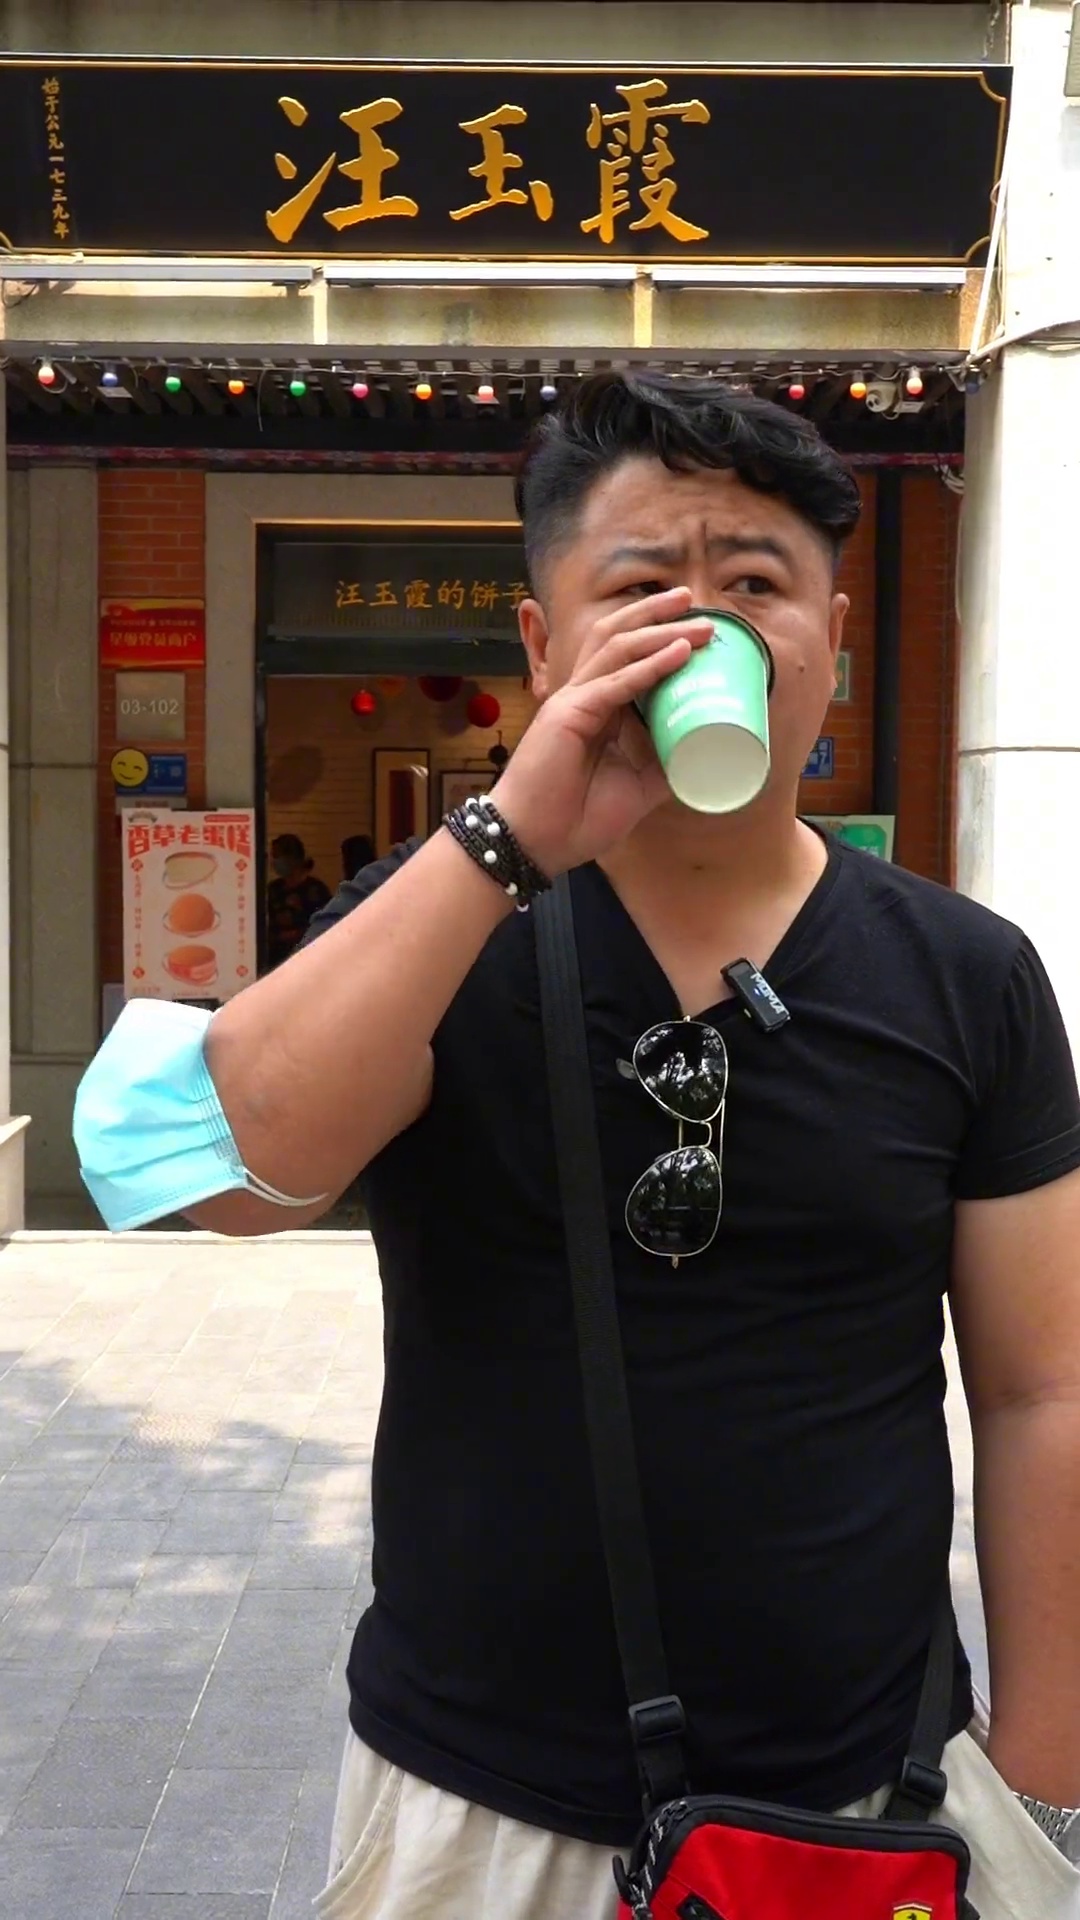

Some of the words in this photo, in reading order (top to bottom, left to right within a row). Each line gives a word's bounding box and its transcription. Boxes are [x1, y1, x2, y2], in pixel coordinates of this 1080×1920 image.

[41, 76, 70, 240] 始于公元一七三九年
[265, 78, 711, 245] 汪玉霞
[335, 579, 531, 610] 汪玉霞的饼子
[120, 698, 180, 716] 03-102
[126, 823, 252, 859] 香草老蛋糕
